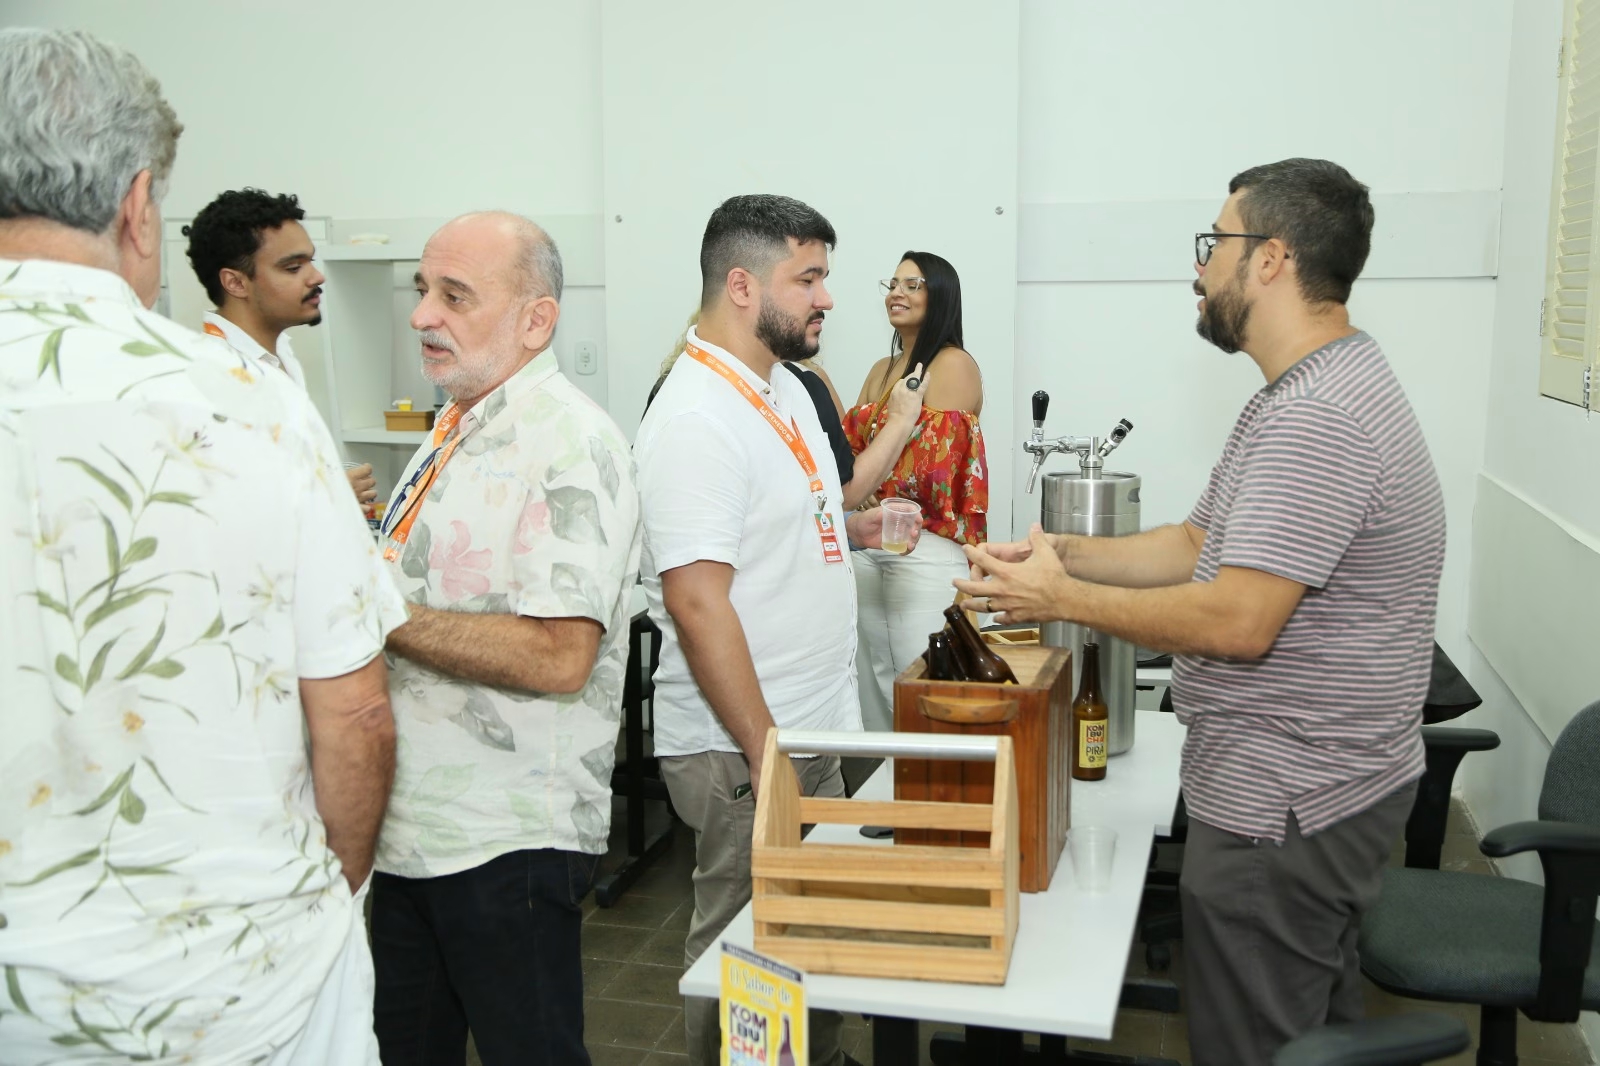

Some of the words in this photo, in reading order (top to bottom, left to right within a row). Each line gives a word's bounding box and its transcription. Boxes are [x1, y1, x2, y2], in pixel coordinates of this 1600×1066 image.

[730, 1002, 767, 1029] KOM
[737, 1023, 759, 1042] BU
[730, 1036, 767, 1063] CHA
